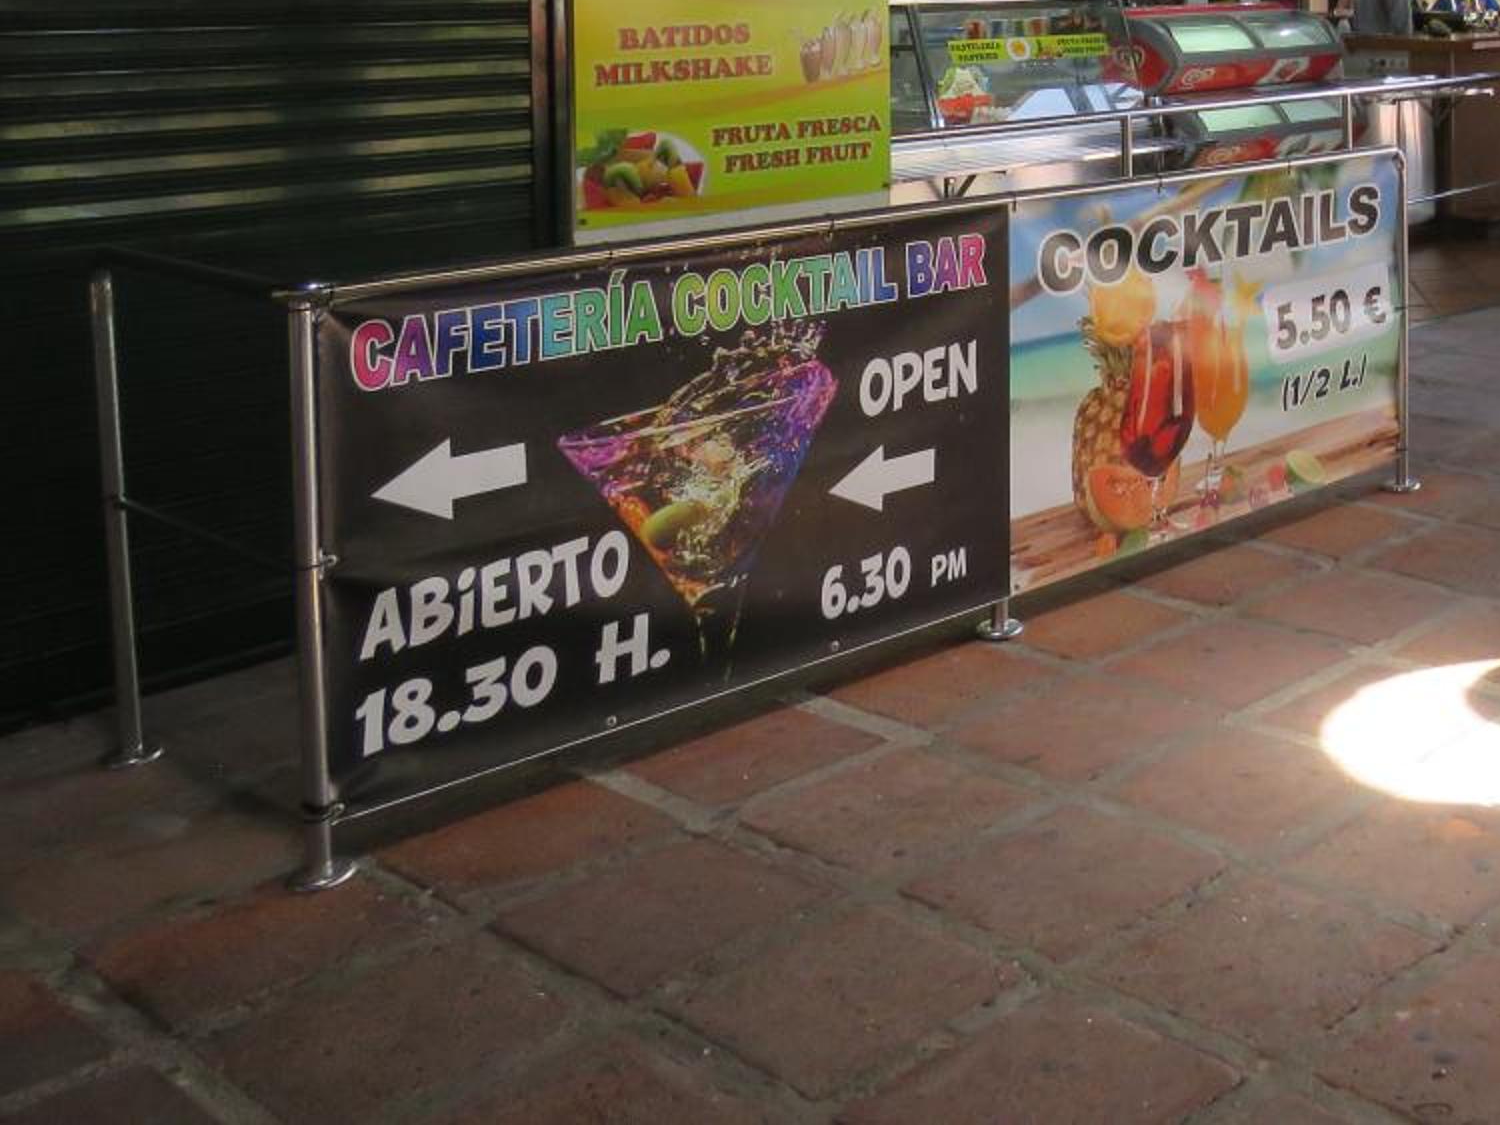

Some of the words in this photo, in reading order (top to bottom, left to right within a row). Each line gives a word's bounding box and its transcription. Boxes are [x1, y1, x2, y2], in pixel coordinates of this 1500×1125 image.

[594, 54, 773, 87] MILKSHAKE
[619, 23, 751, 51] BATIDOS
[712, 121, 790, 147] FRUTA
[797, 114, 882, 142] FRESCA
[724, 145, 800, 173] FRESH
[805, 141, 873, 165] FRUIT
[1039, 184, 1381, 294] COCKTAILS
[351, 269, 664, 392] CAFETERÍA
[672, 246, 898, 337] COCKTAIL
[906, 232, 988, 299] BAR
[1276, 288, 1351, 350] 5.50
[858, 339, 978, 418] OPEN
[821, 546, 911, 620] 6.30
[931, 547, 967, 587] PM
[354, 645, 557, 758] 18.30
[595, 612, 671, 684] H.
